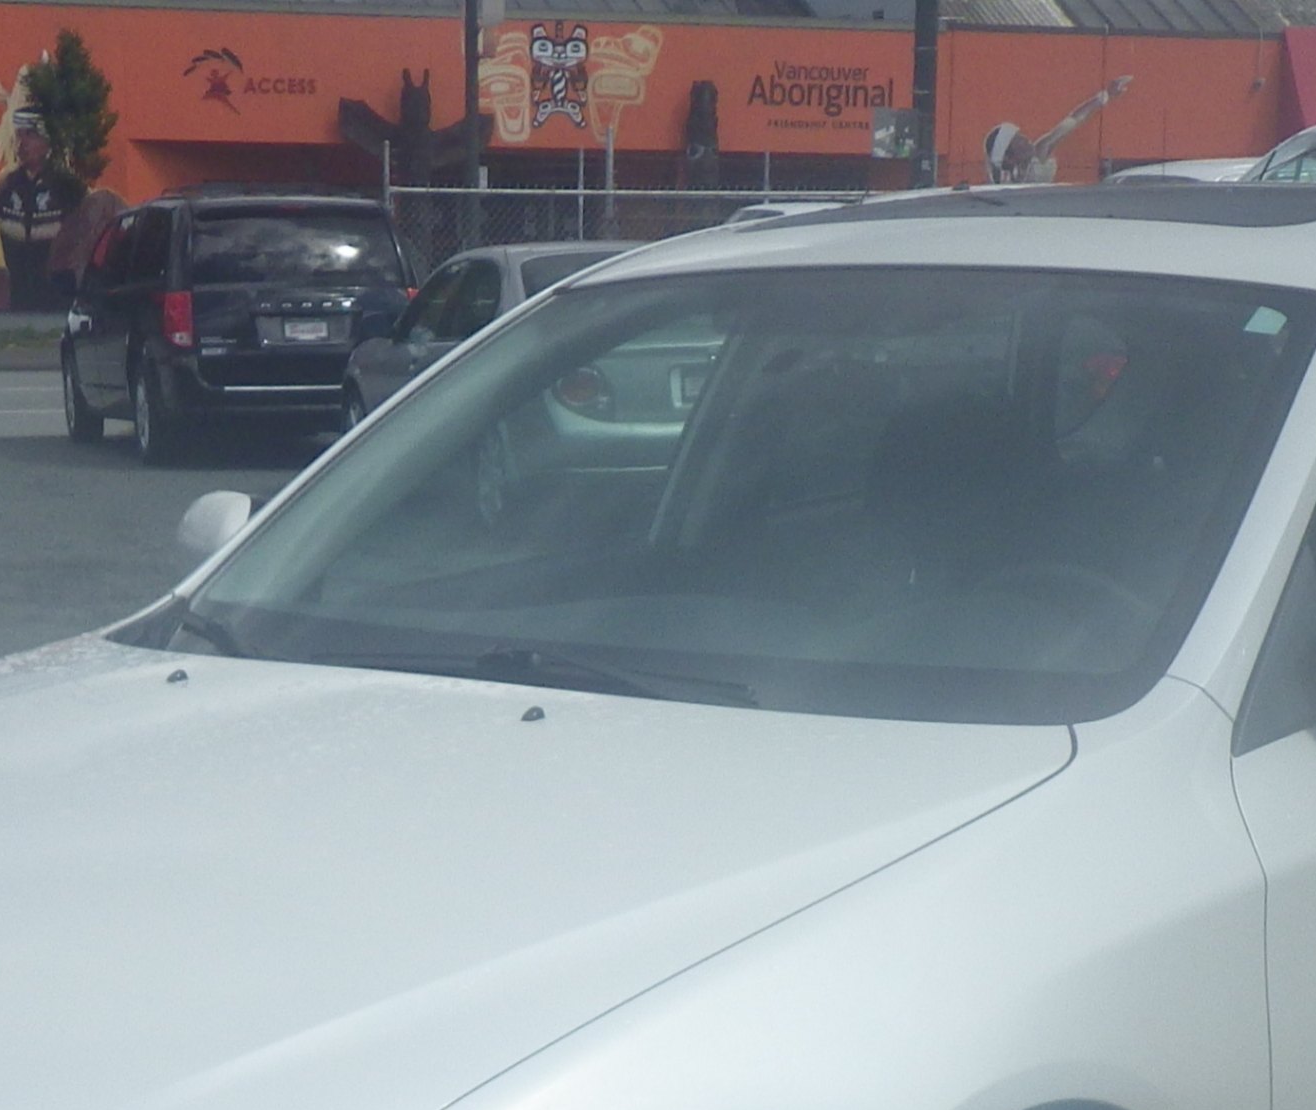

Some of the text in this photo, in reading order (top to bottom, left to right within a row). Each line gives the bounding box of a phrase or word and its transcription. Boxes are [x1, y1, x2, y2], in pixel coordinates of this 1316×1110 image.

[774, 60, 870, 81] Vancouver
[243, 77, 317, 94] ACCESS
[747, 74, 893, 117] Aboriginal
